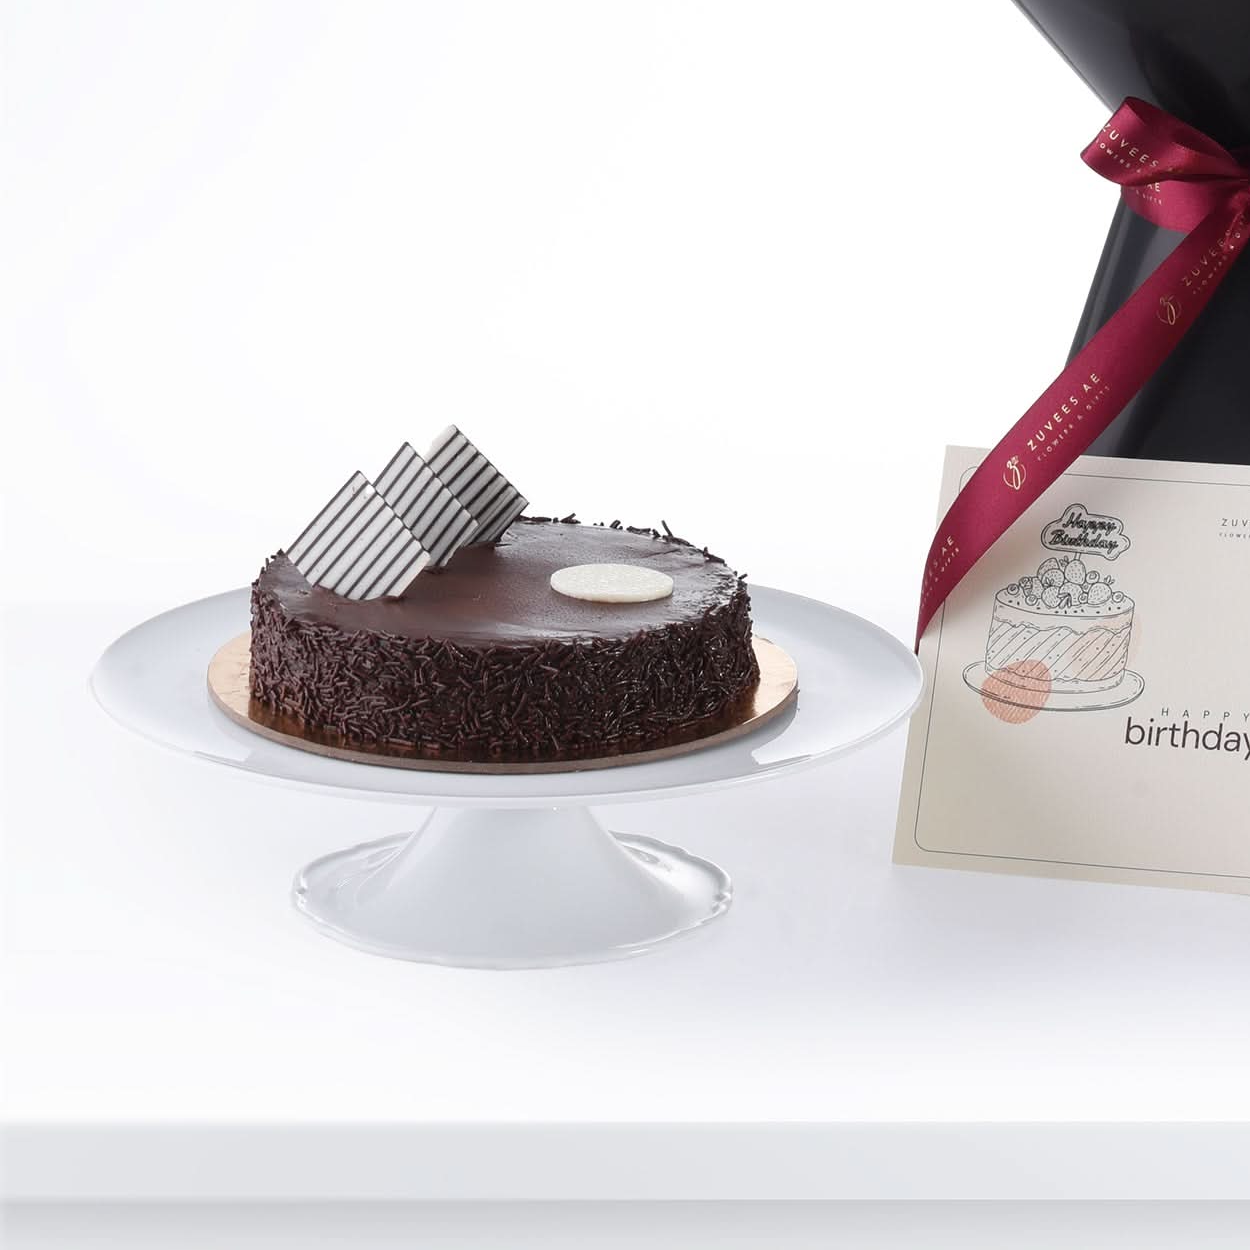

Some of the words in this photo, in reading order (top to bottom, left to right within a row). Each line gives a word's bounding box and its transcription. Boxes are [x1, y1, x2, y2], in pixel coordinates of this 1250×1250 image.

[1062, 512, 1117, 536] Happy
[1048, 529, 1119, 554] Birthday
[1161, 707, 1250, 722] HAPPY
